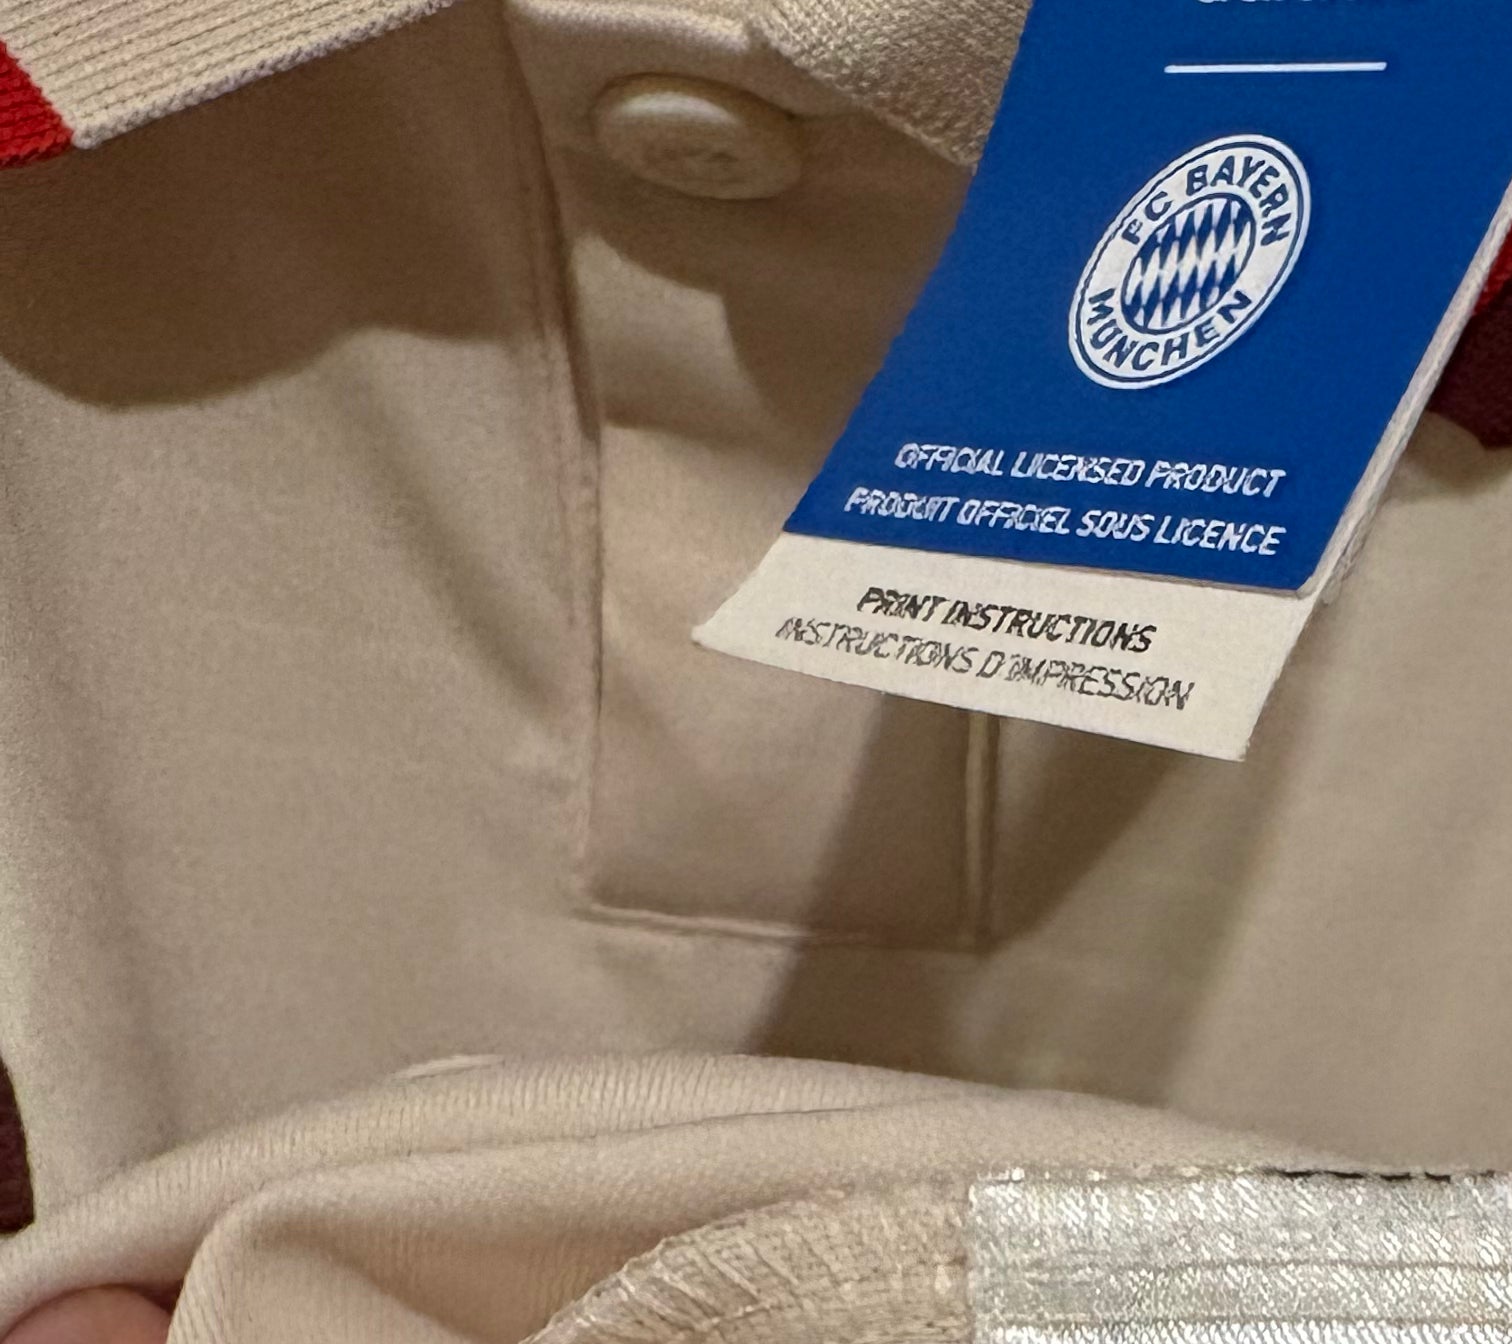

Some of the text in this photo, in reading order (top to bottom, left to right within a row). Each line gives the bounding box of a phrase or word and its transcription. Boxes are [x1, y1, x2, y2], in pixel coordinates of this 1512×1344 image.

[1122, 155, 1292, 246] FC BAYERN
[895, 442, 1286, 499] OFFICIAL LICENSED PRODUCT
[844, 487, 1286, 556] PRODUIT OFFICIEL SOUS LICENCE
[775, 615, 979, 674] INSTRUCTIONS
[857, 586, 1157, 653] PRINT INSTRUCTIONS
